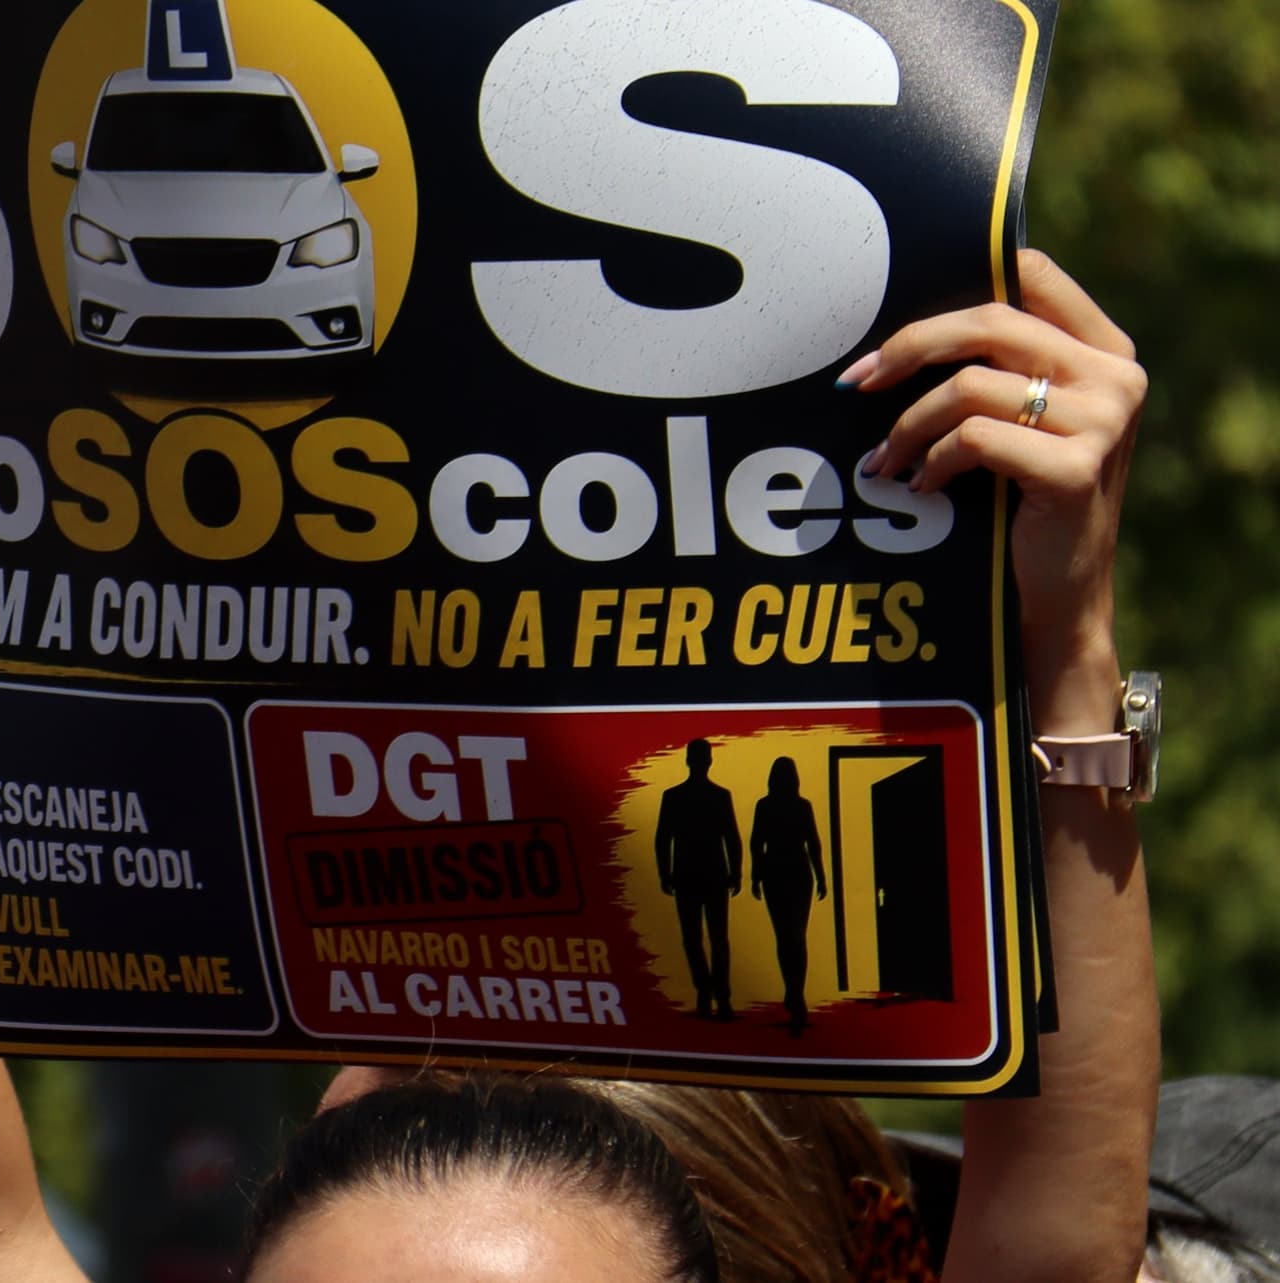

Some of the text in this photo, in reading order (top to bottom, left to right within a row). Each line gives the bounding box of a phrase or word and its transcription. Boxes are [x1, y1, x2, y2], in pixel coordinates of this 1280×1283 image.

[165, 10, 208, 68] L
[38, 574, 72, 650] A
[90, 578, 370, 665] CONDUIR.
[391, 589, 481, 668] NO
[499, 590, 546, 668] A
[573, 587, 713, 668] FER
[733, 581, 937, 666] CUES.
[302, 730, 527, 822] DGT
[113, 846, 203, 890] CODI.
[307, 827, 562, 908] DIMISSIÓ
[312, 927, 612, 974] NAVARRO I SOLER
[329, 970, 628, 1026] AL CARRER
